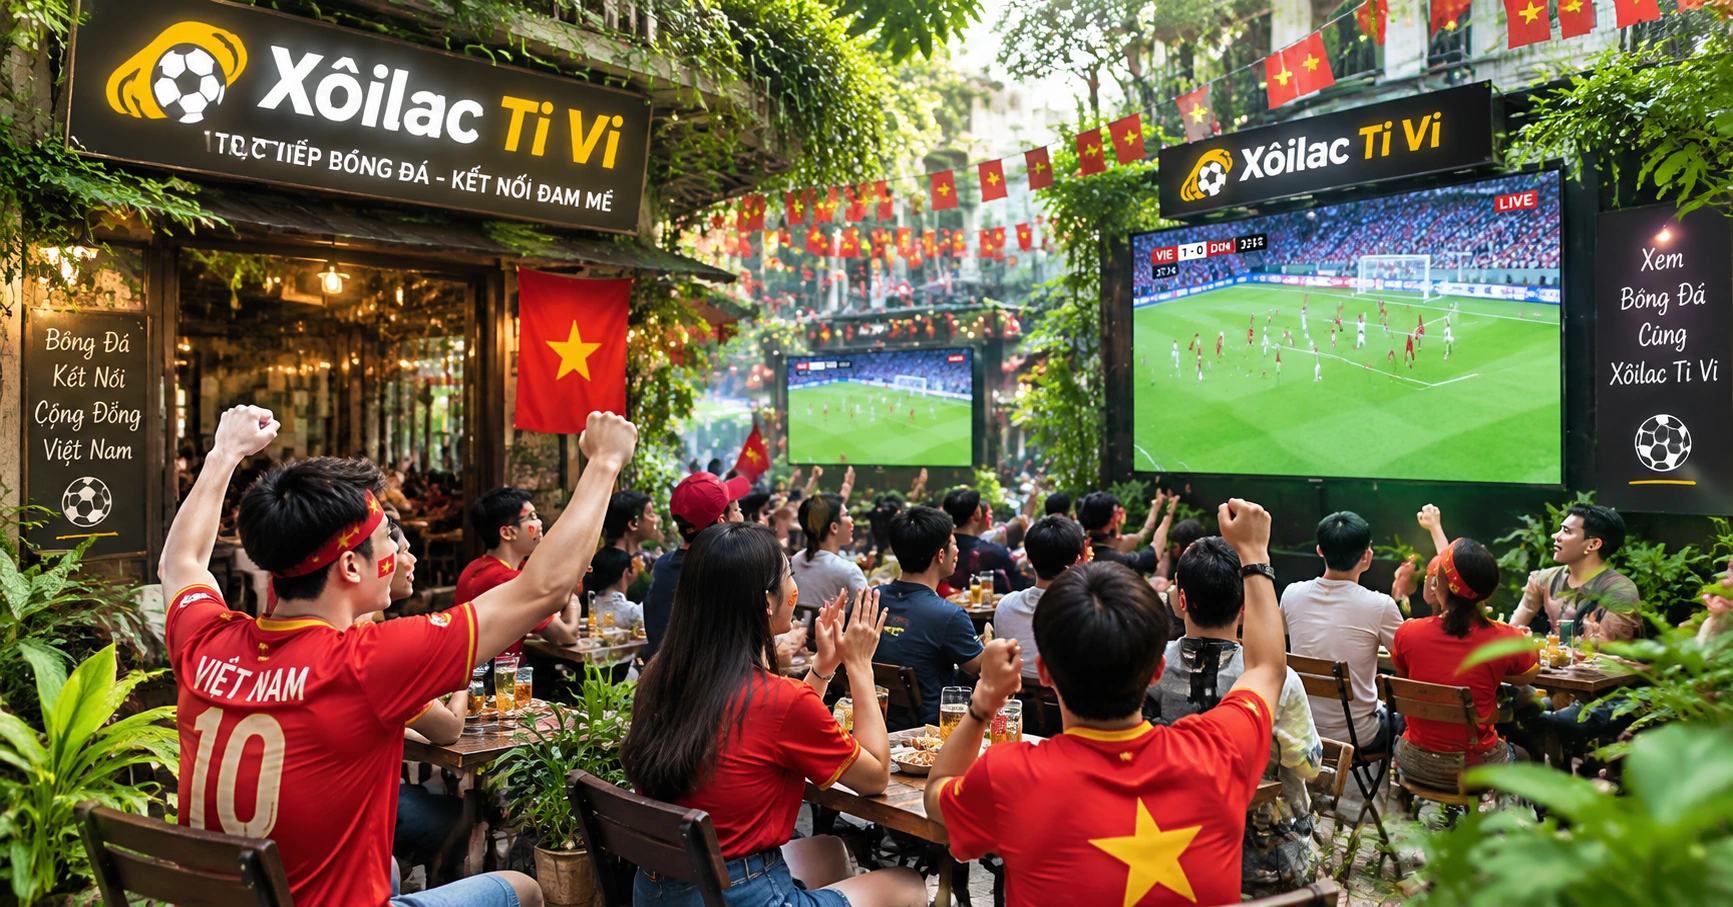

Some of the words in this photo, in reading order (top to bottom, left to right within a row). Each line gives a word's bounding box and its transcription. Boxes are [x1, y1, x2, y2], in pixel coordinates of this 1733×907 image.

[257, 45, 484, 144] Xôilac
[501, 95, 554, 157] Ti
[568, 108, 624, 169] Vi
[1239, 136, 1350, 182] Xôilac
[1358, 121, 1393, 160] Ti
[1402, 111, 1442, 152] Vi
[398, 160, 430, 185] ĐÁ
[537, 184, 581, 208] ĐAM
[1499, 193, 1534, 210] LIVE
[1156, 249, 1174, 261] VIE
[1640, 247, 1684, 272] Xem
[1676, 281, 1706, 306] Đá
[103, 331, 130, 353] Đá
[1609, 360, 1668, 386] Xôilac
[1673, 359, 1692, 383] Ti
[1699, 358, 1719, 382] Vi
[43, 437, 83, 467] Việt
[90, 438, 133, 460] Nam
[245, 666, 310, 703] NAM
[189, 706, 286, 838] 10
